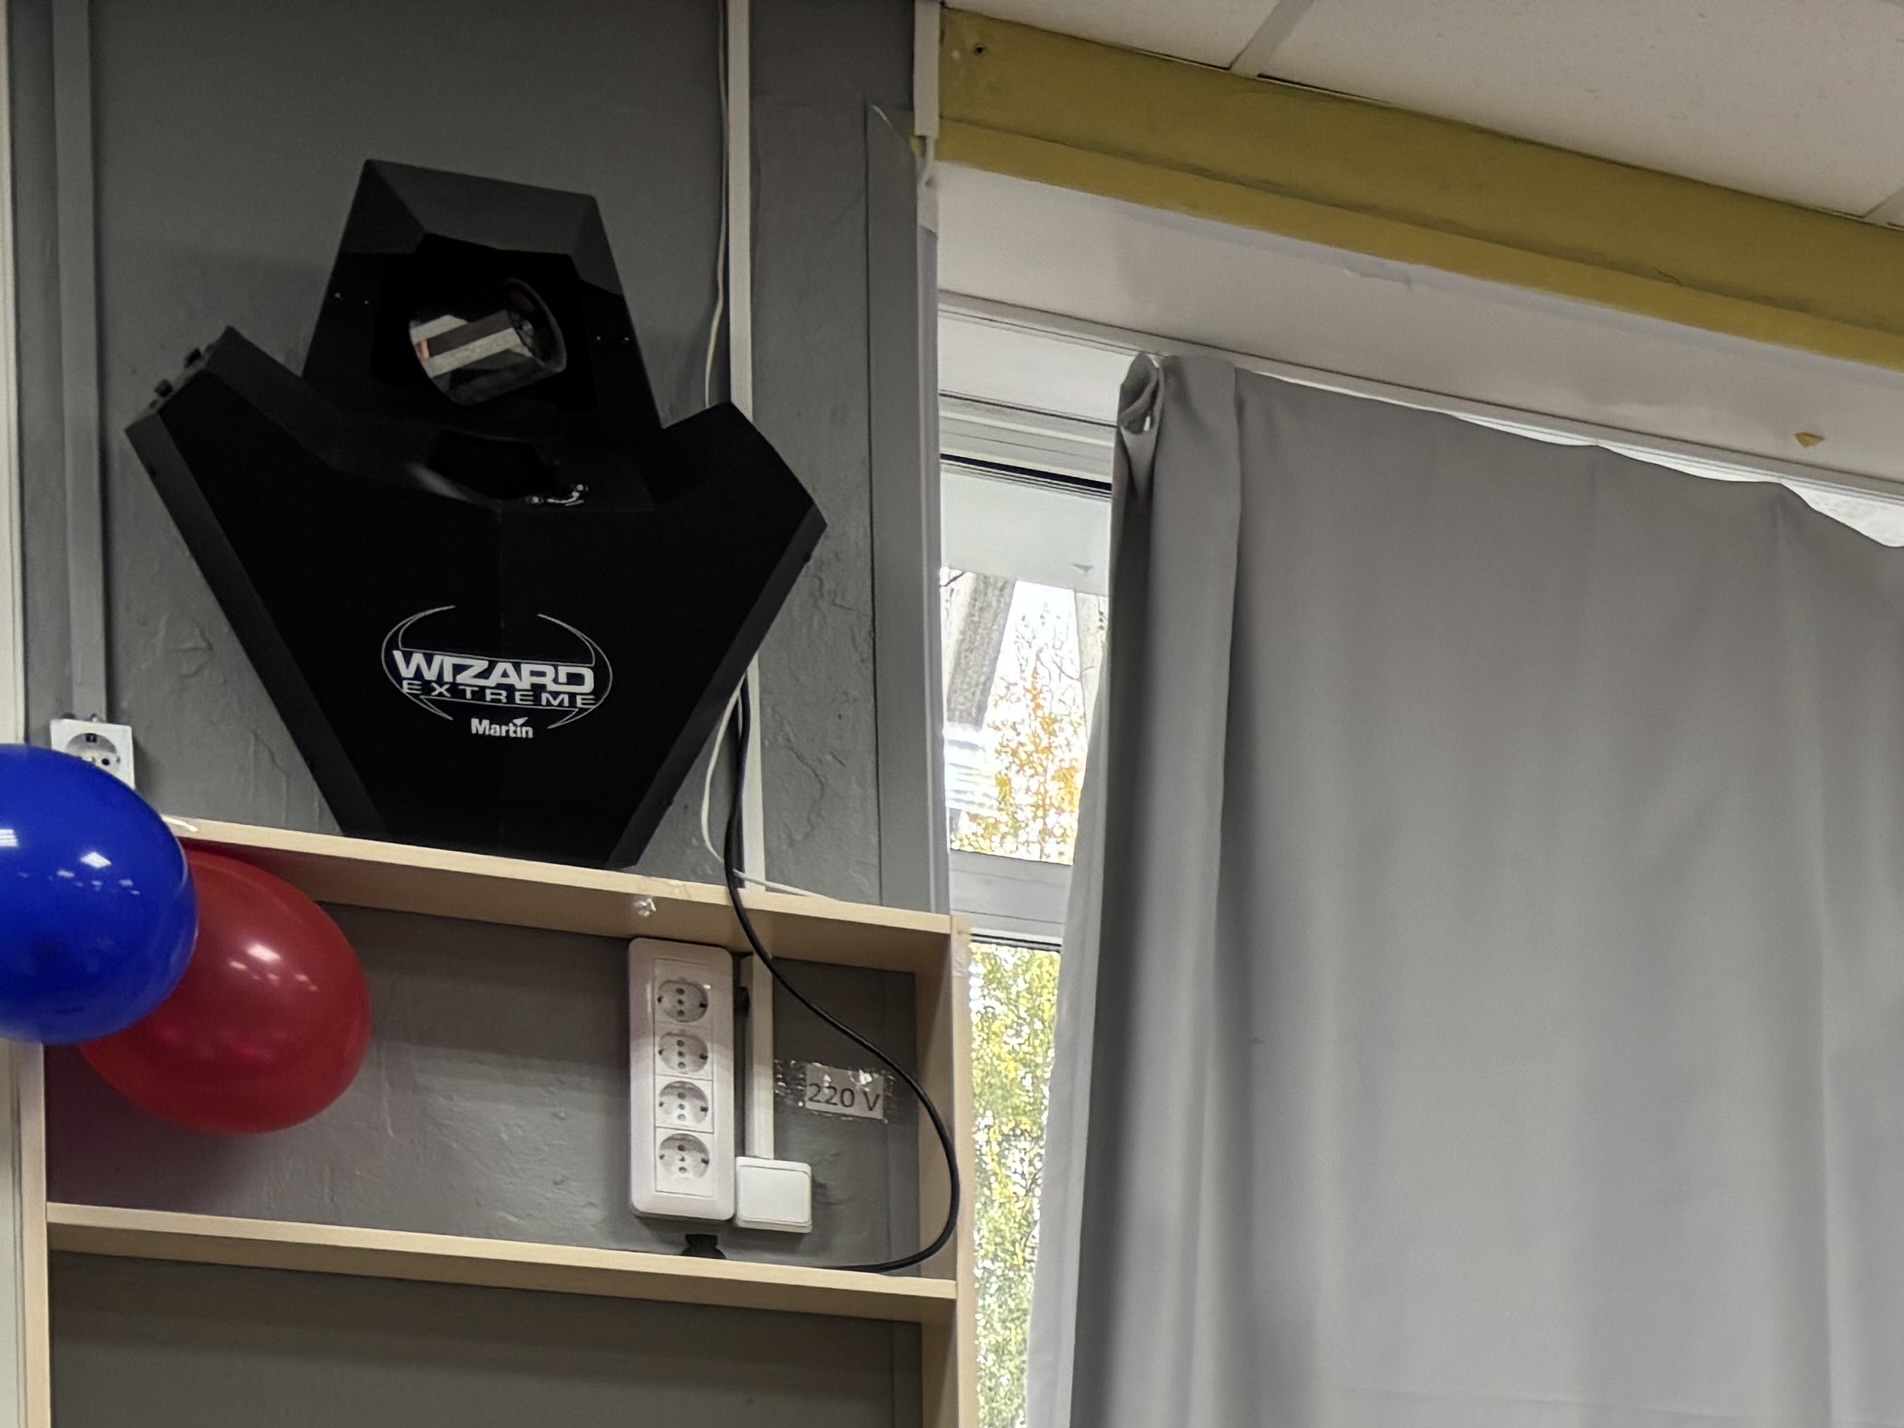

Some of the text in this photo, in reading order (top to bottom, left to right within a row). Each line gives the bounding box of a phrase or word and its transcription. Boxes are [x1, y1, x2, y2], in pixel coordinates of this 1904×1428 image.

[392, 650, 595, 694] WIZARD
[401, 679, 597, 709] EXTREME
[470, 716, 534, 739] Martin
[807, 1083, 881, 1111] 220 V
